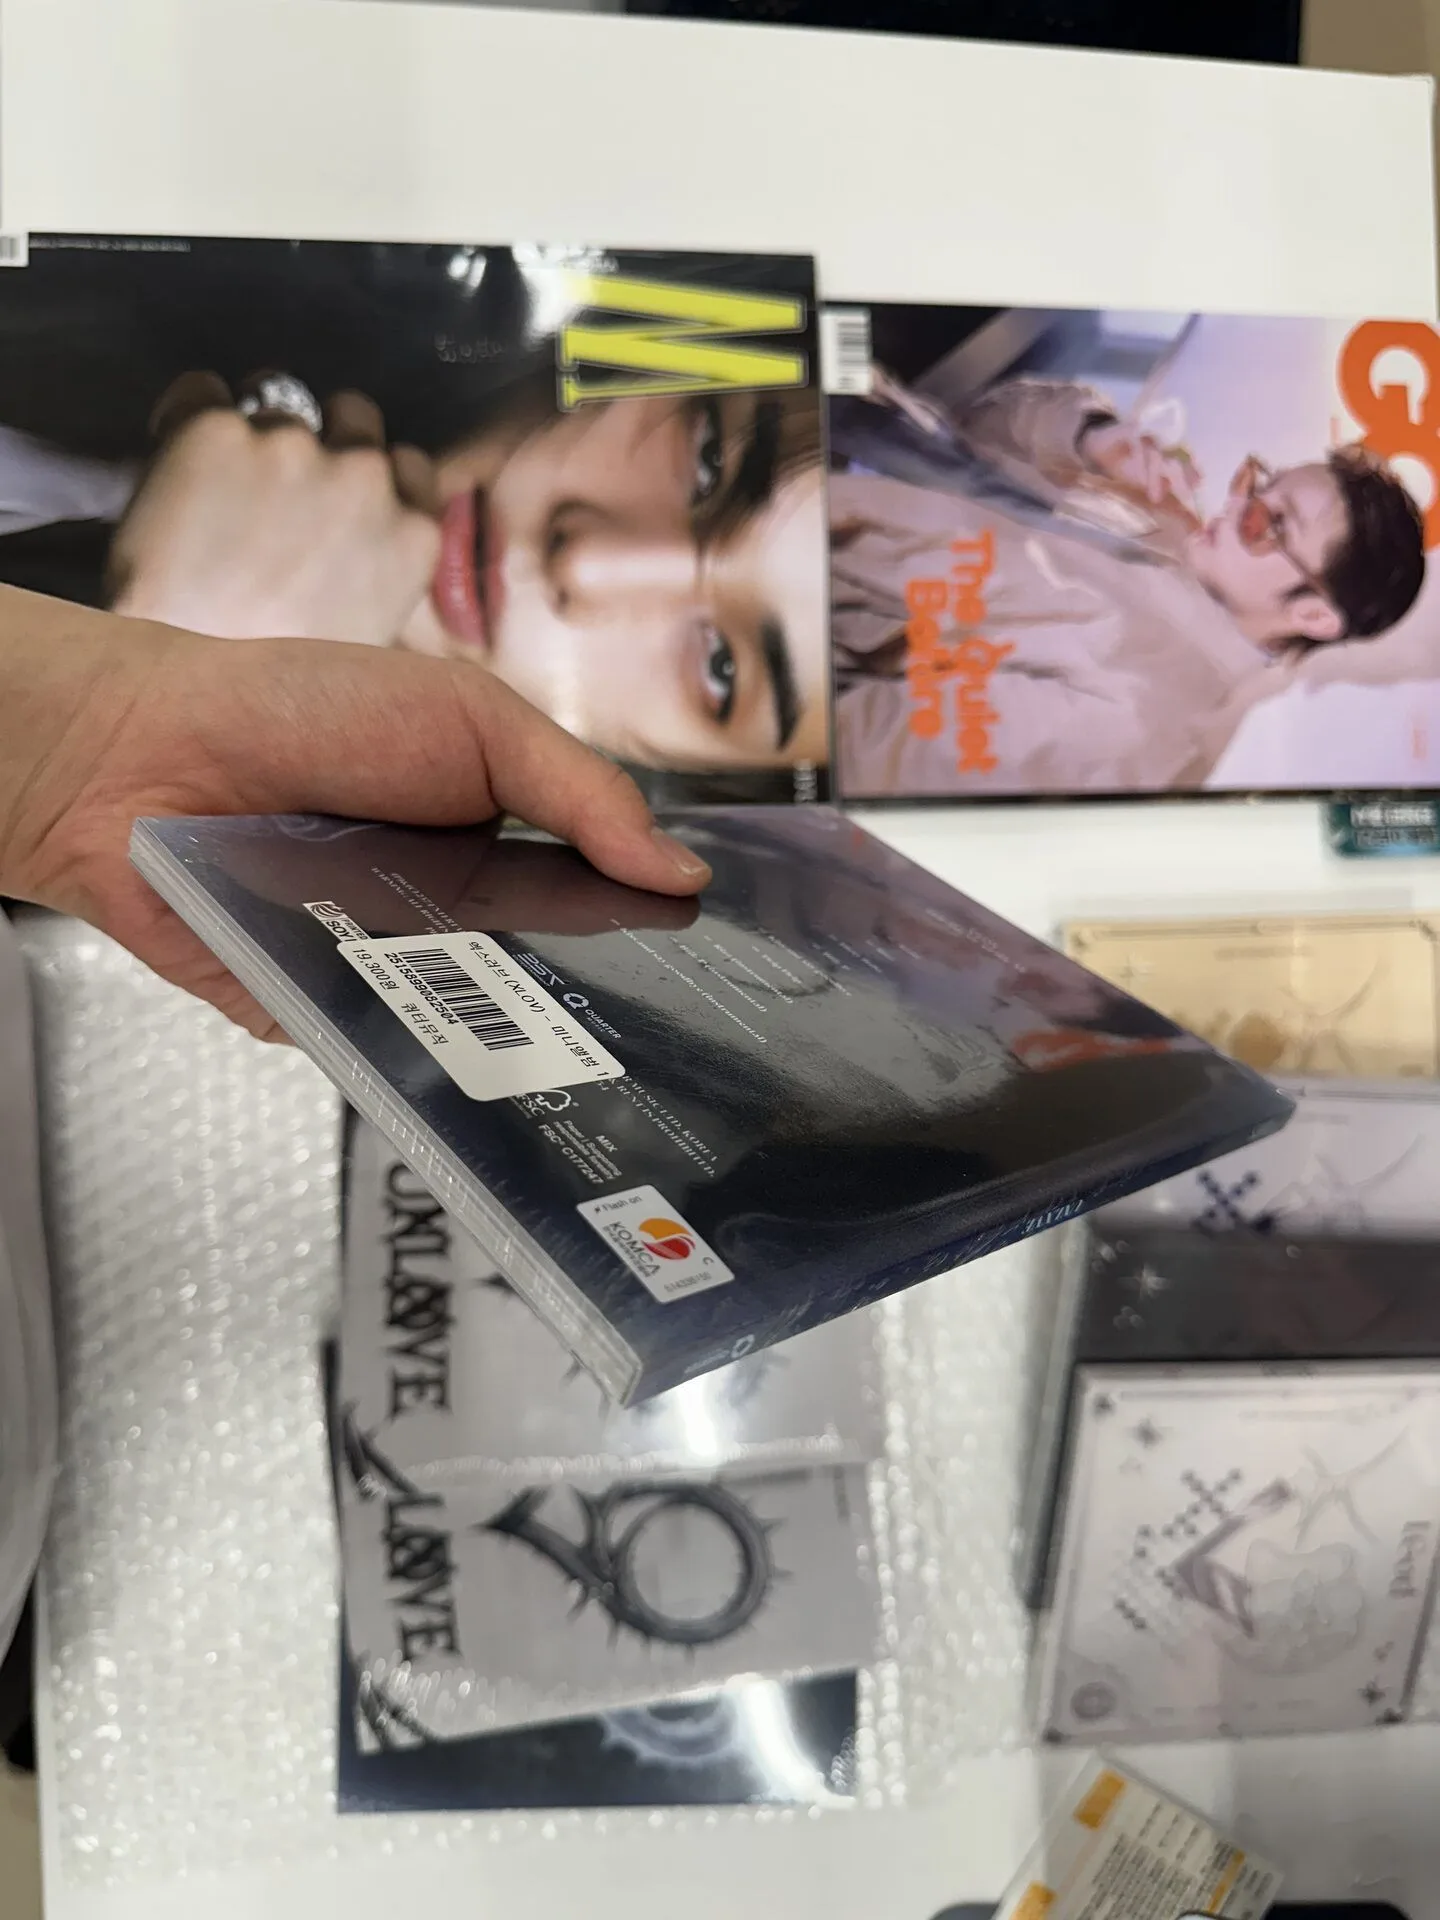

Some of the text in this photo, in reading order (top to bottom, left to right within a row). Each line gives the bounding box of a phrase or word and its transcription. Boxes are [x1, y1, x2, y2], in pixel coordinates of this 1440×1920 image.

[949, 530, 1016, 774] The Quiet
[325, 920, 351, 938] SOY
[341, 919, 367, 939] PRINTED
[351, 948, 447, 1044] 19,300원 쿼터뮤직
[384, 953, 459, 1025] 2515899082504
[465, 941, 510, 977] 엑스러브
[503, 979, 545, 1013] (XLOV)
[550, 1025, 599, 1067] 미니앨범
[584, 1009, 621, 1038] QUARTER
[561, 1146, 602, 1184] C177247
[562, 1120, 585, 1138] Paper
[584, 1142, 622, 1176] Supporting
[595, 1135, 617, 1152] MIX
[682, 1130, 719, 1161] KOREA
[610, 1221, 660, 1275] KOMCA
